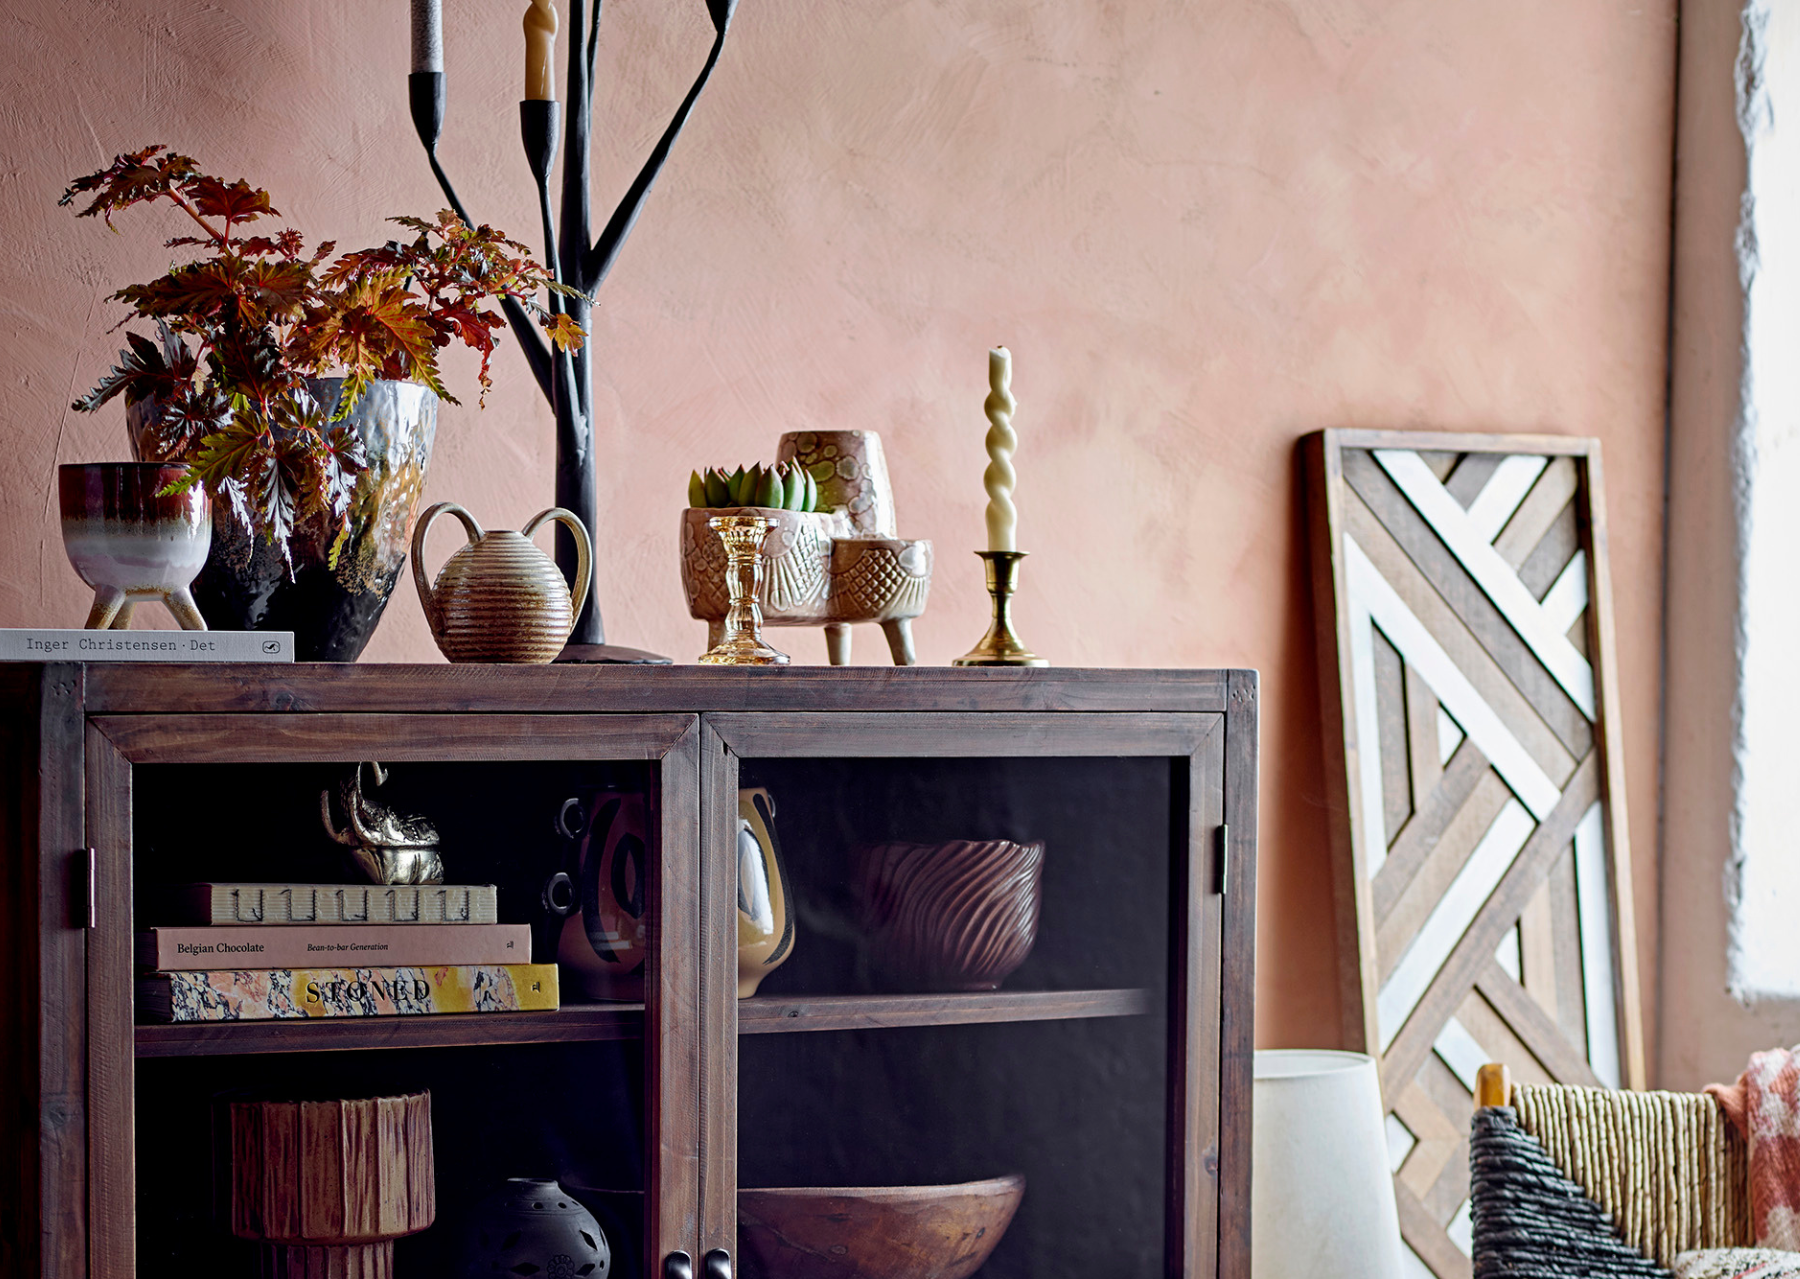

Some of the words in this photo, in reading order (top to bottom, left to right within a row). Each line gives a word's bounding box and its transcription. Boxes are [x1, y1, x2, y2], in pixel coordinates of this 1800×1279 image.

[26, 638, 69, 653] Inger
[79, 638, 177, 651] Christensen
[190, 639, 216, 651] Det
[177, 943, 214, 956] Belgian
[216, 943, 265, 954] Chocolate
[306, 943, 349, 952] Bean-to-bar
[350, 943, 389, 951] Generation
[306, 979, 431, 1004] STONED
